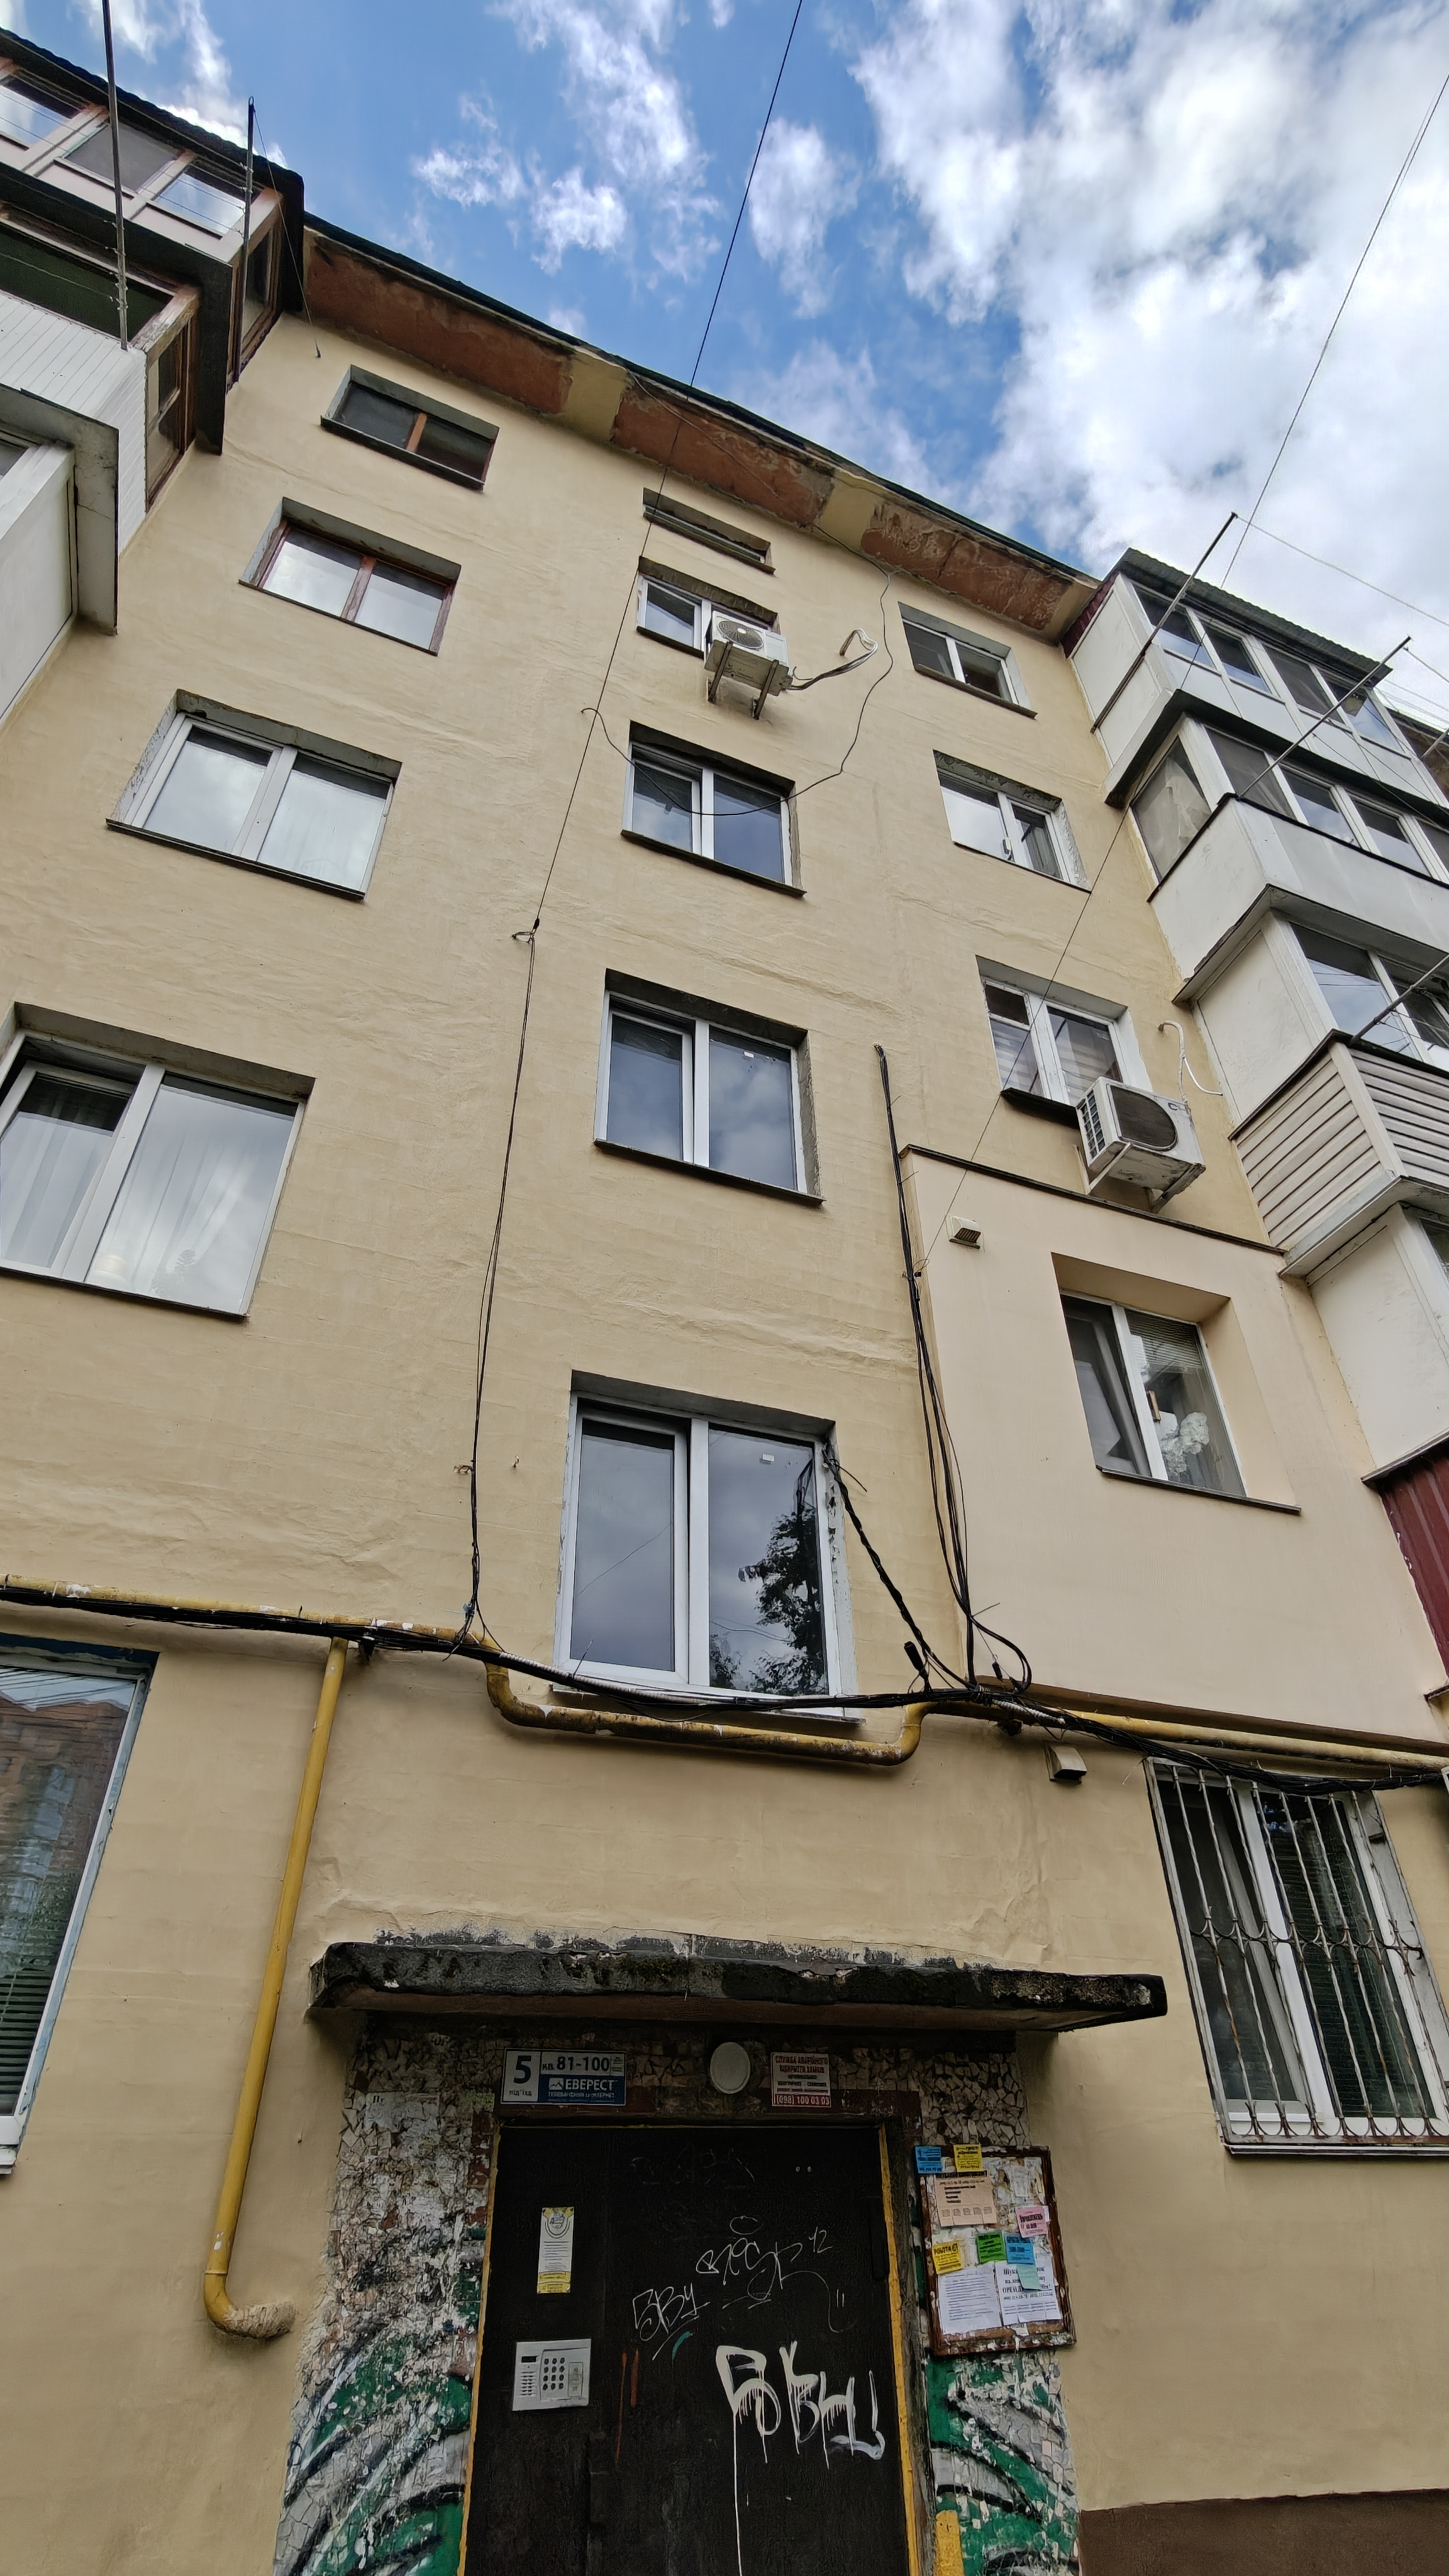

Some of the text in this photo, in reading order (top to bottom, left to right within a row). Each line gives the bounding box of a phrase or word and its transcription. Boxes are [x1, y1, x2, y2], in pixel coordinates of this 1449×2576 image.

[513, 2055, 532, 2084] 5
[557, 2056, 609, 2071] 81-100
[565, 2079, 615, 2091] ЕВЕРЕСТ
[797, 2096, 809, 2104] 100
[811, 2096, 819, 2105] 03
